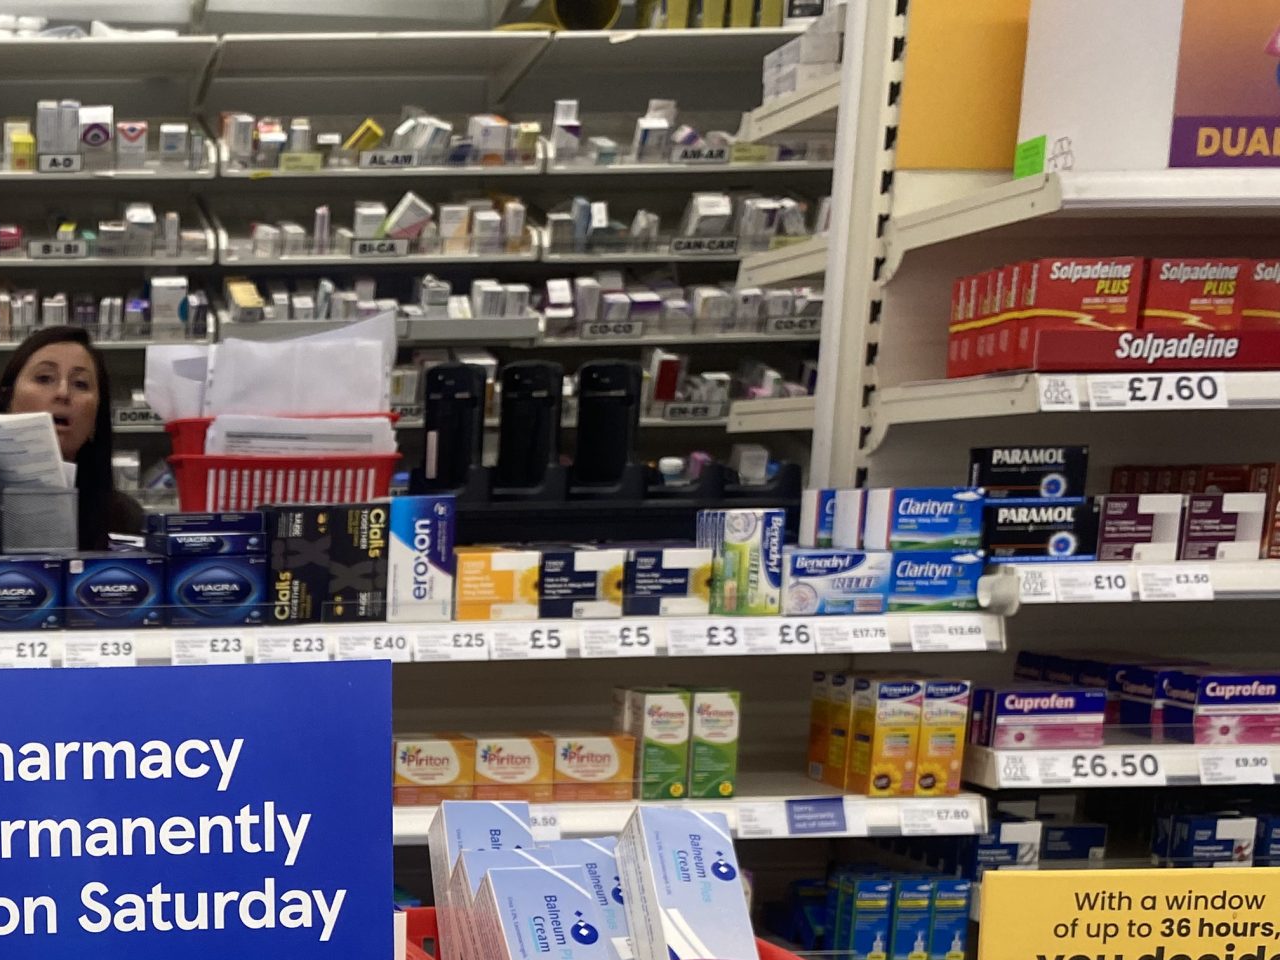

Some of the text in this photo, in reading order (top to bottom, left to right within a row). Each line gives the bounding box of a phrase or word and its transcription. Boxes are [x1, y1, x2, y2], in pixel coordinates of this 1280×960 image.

[1050, 262, 1131, 294] Solpadeine PLUS
[1159, 263, 1238, 281] Solpadeine
[1203, 281, 1237, 295] PLUS
[1115, 333, 1239, 363] Solpadeine
[1128, 376, 1218, 401] £7.60
[992, 449, 1065, 465] PARAMOL
[998, 507, 1075, 524] PARAMOL
[413, 519, 431, 600] eroxon
[795, 555, 851, 570] Benadryl
[896, 561, 952, 579] Clarityn
[1176, 574, 1209, 584] £3.50
[192, 584, 241, 592] VIAGRA
[1095, 575, 1126, 590] £10
[373, 636, 406, 650] £40
[452, 634, 484, 648] £25
[619, 627, 650, 646] £5
[707, 626, 737, 646] £3
[779, 625, 810, 644] £6
[16, 642, 48, 658] £12
[100, 642, 132, 657] £39
[210, 639, 242, 653] £23
[293, 638, 325, 653] £23
[1205, 682, 1276, 700] Cuprofen
[1004, 695, 1075, 713] Cuprofen
[568, 749, 611, 765] Piriton
[1072, 754, 1159, 777] £6.50
[1235, 757, 1268, 767] £9.90
[531, 817, 557, 827] 9.50
[937, 810, 969, 820] £7.80
[689, 834, 706, 878] Balneum
[676, 850, 691, 883] Cream
[78, 877, 347, 942] Saturday
[1074, 890, 1266, 911] With a window
[544, 895, 567, 945] Balneum
[1054, 918, 1280, 944] of up to 36 hours,
